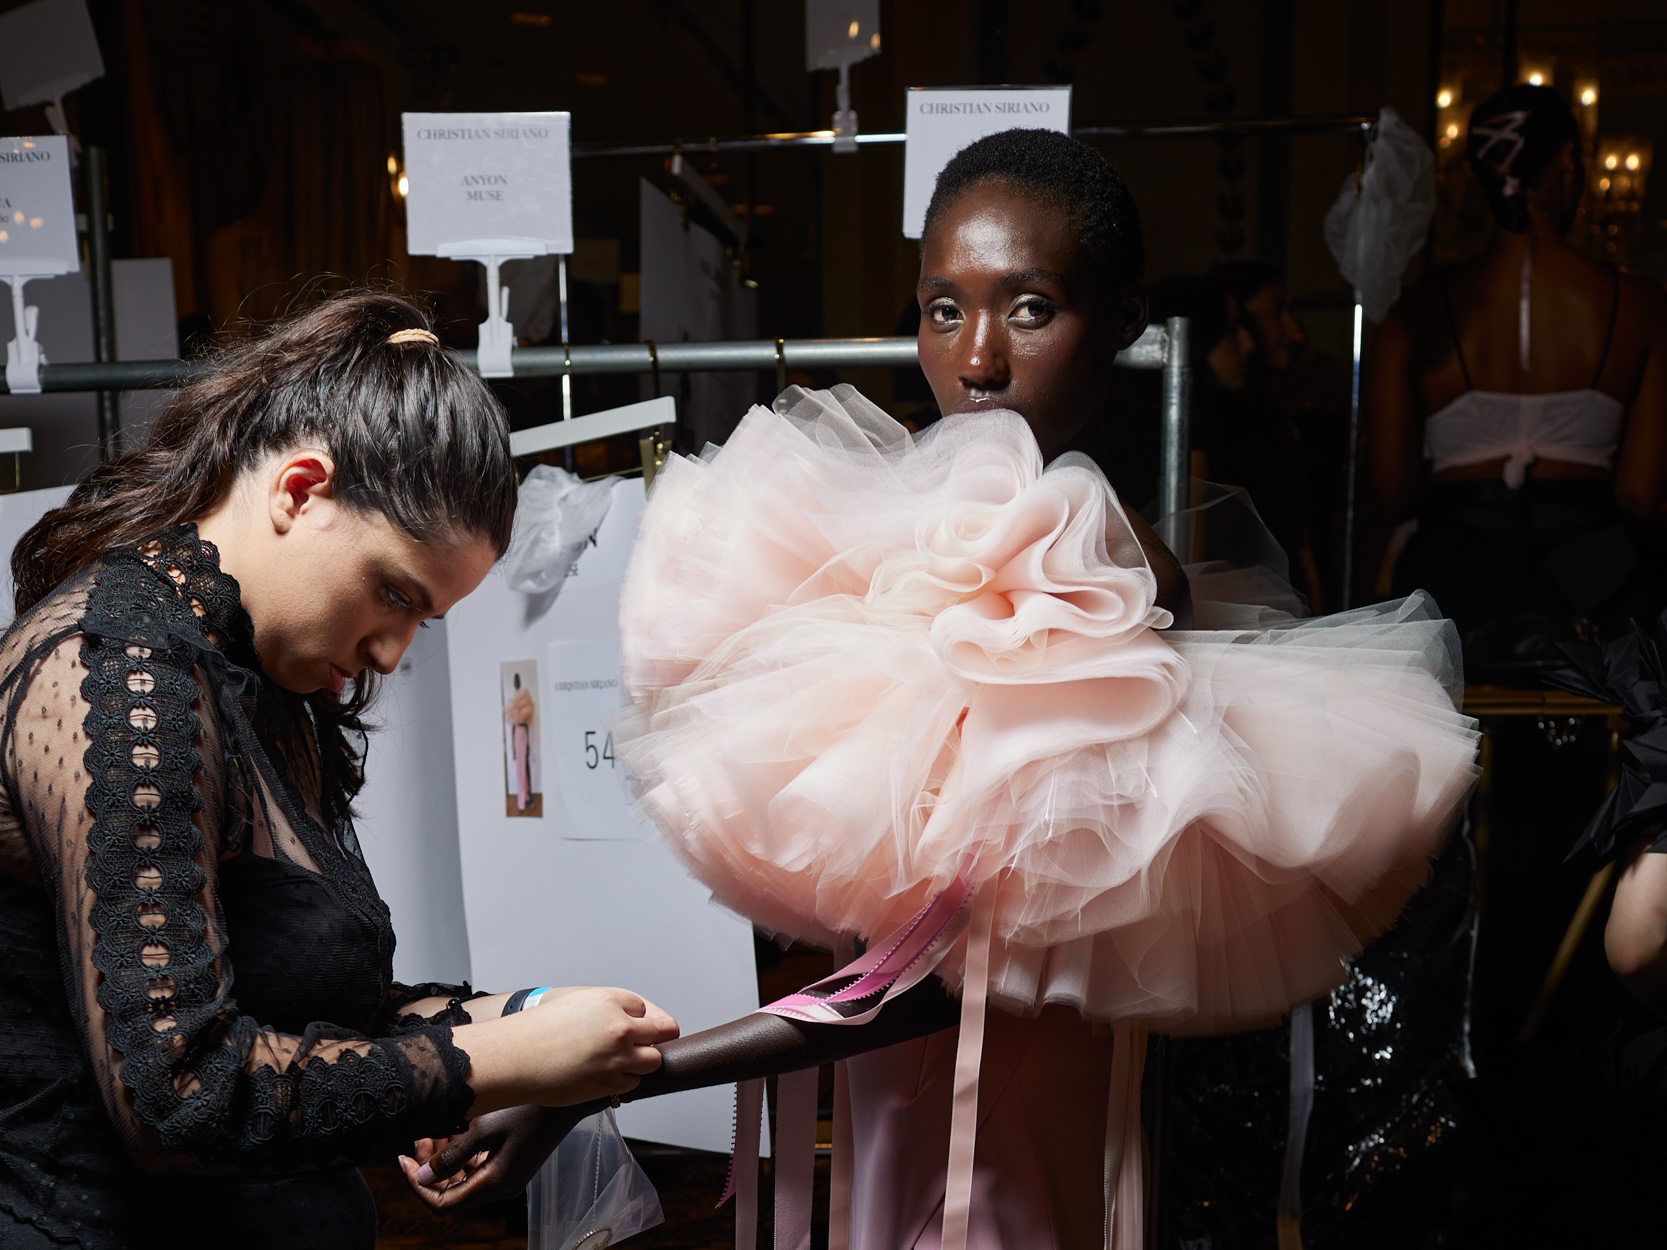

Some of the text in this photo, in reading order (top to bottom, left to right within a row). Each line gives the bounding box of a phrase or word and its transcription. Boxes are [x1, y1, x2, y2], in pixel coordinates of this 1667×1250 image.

[920, 101, 1050, 114] CHRISTIAN SIRIANO
[417, 128, 549, 140] CHRISTIAN SIRIANO
[460, 174, 508, 186] ANYON
[466, 190, 504, 201] MUSE
[585, 731, 615, 769] 54
